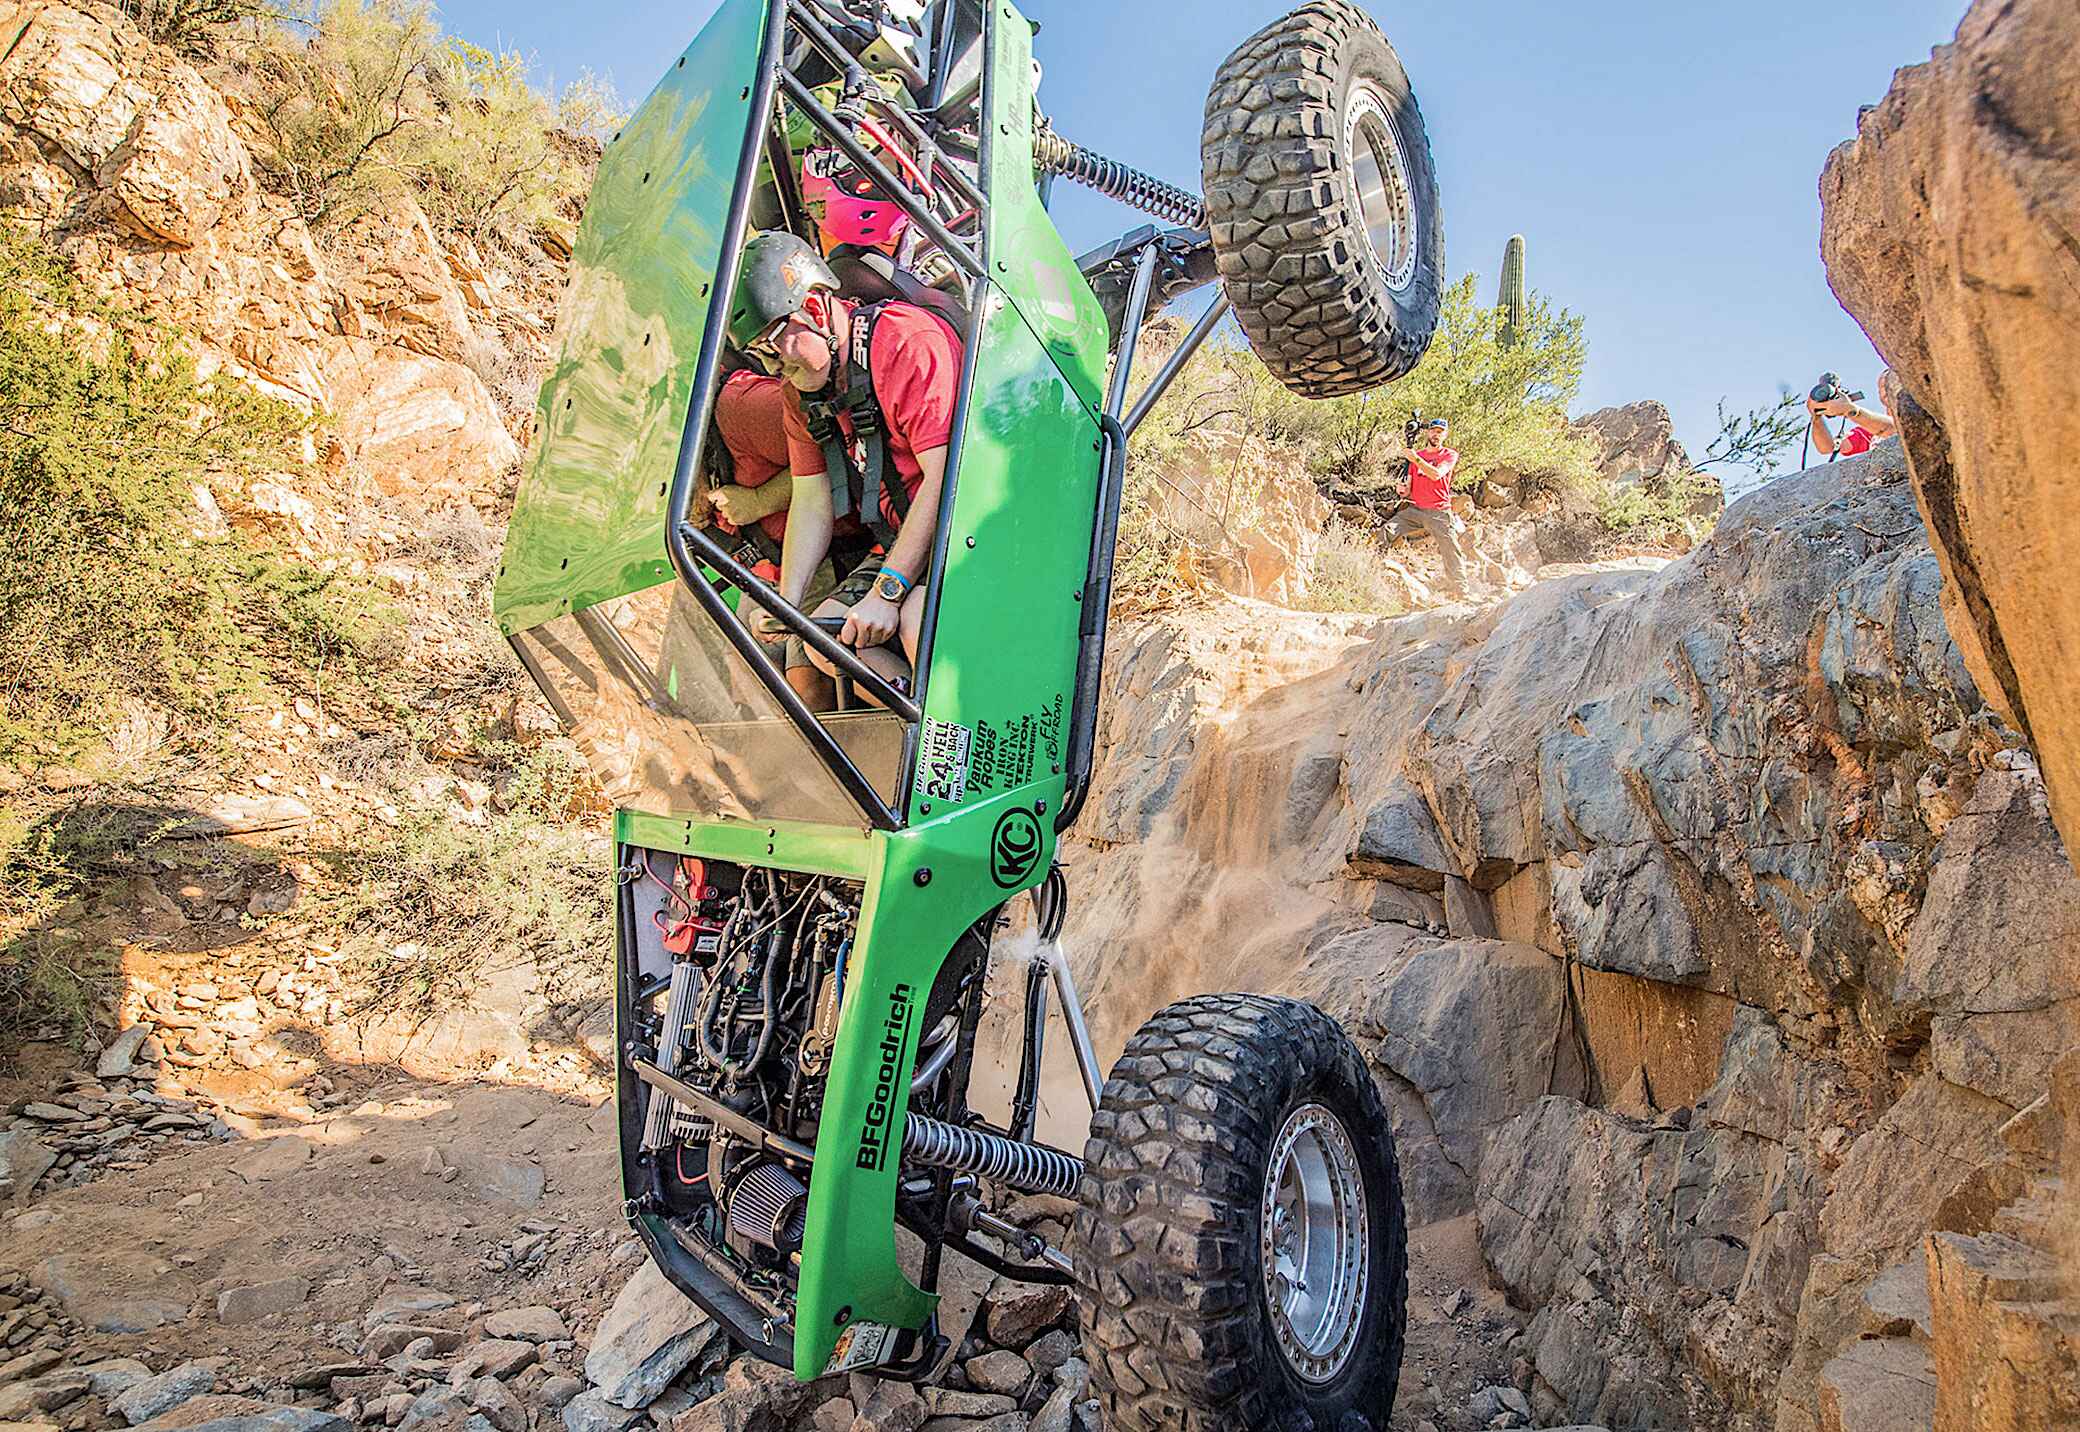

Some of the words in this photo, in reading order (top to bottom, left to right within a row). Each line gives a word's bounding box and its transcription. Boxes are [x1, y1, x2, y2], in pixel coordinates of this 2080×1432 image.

[932, 722, 950, 758] HELL
[948, 723, 960, 751] BACK
[1009, 722, 1020, 749] INC
[1040, 704, 1052, 740] FLY
[916, 717, 933, 793] BFGoodrich
[965, 719, 988, 794] Yankum
[980, 728, 997, 789] Ropes
[996, 737, 1009, 775] IRON
[1014, 715, 1030, 785] TEKTON
[927, 762, 953, 801] 24
[1004, 752, 1017, 788] KING
[997, 822, 1037, 876] KC
[856, 983, 910, 1170] BFGoodrich
